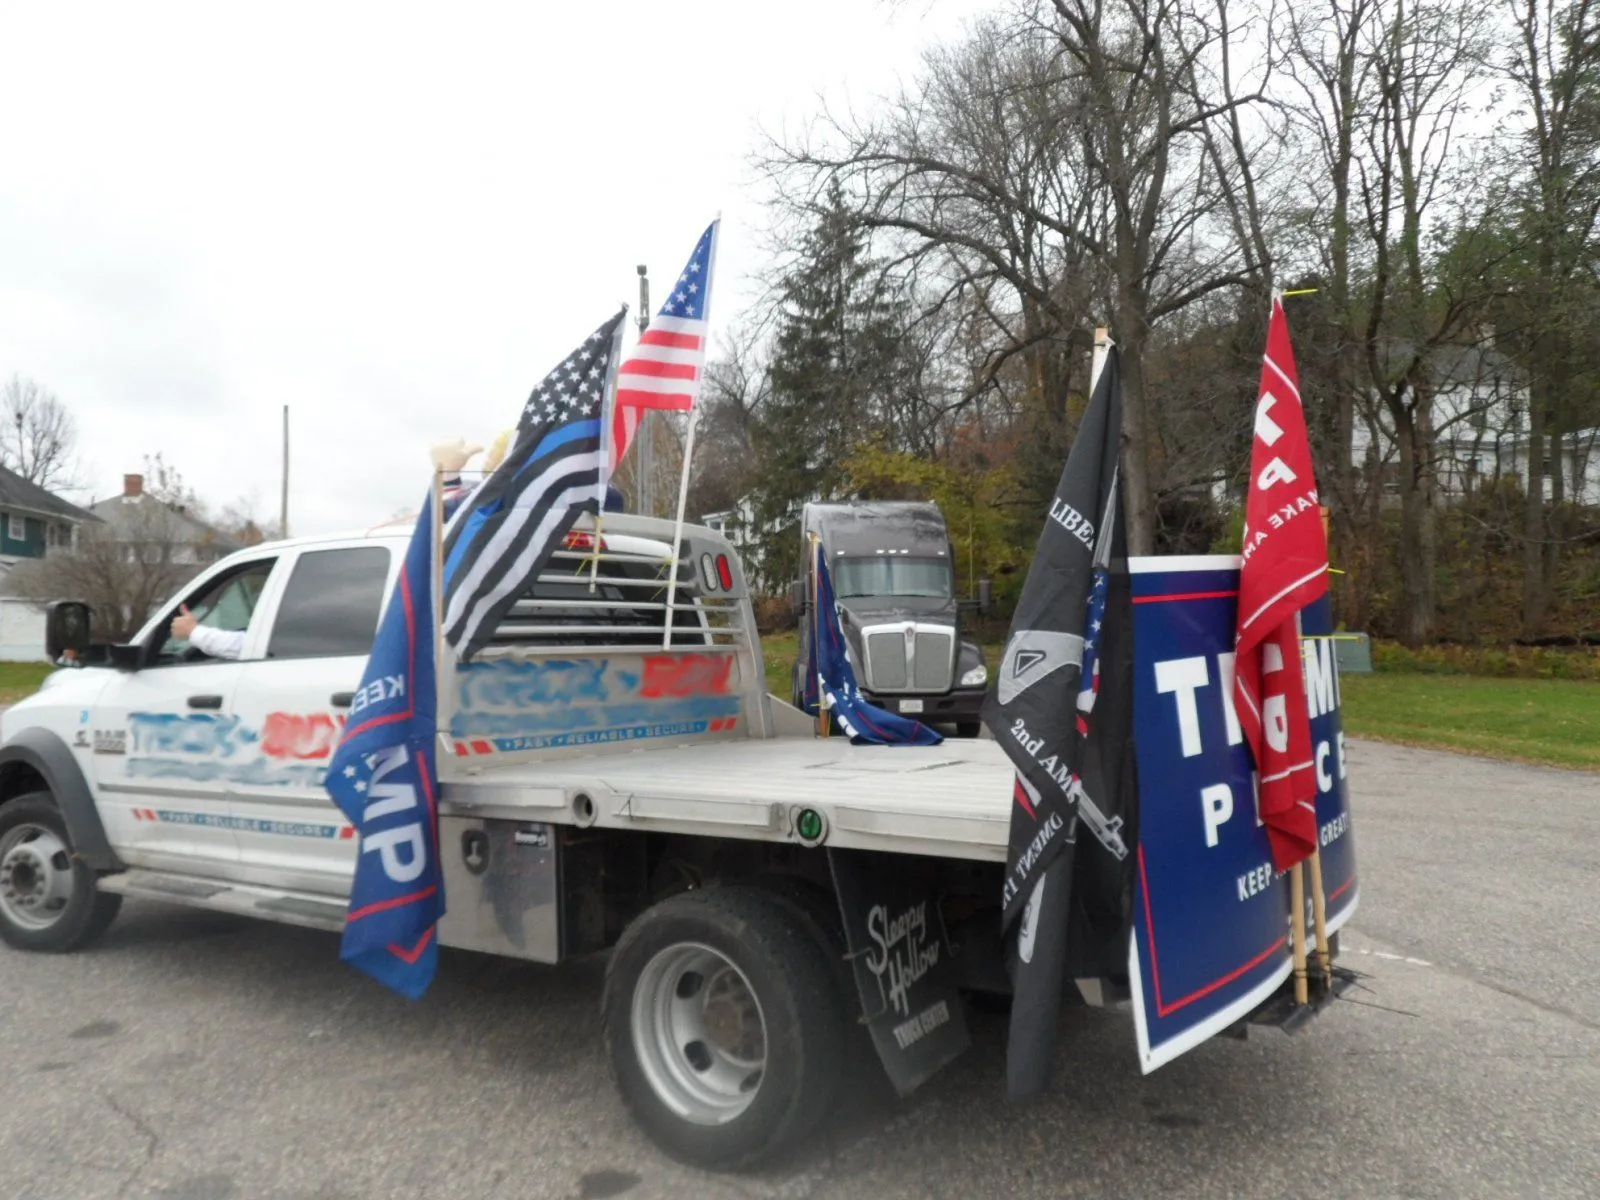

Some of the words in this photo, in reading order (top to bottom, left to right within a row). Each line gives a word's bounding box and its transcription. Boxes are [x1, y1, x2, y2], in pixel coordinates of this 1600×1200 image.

[514, 736, 553, 750] FAST
[566, 728, 635, 745] RELIABLE
[646, 722, 695, 737] SECURE
[1010, 718, 1045, 757] 2nd
[1236, 862, 1272, 902] KEEP
[866, 901, 927, 976] Sleepy
[889, 938, 940, 1017] Hollow
